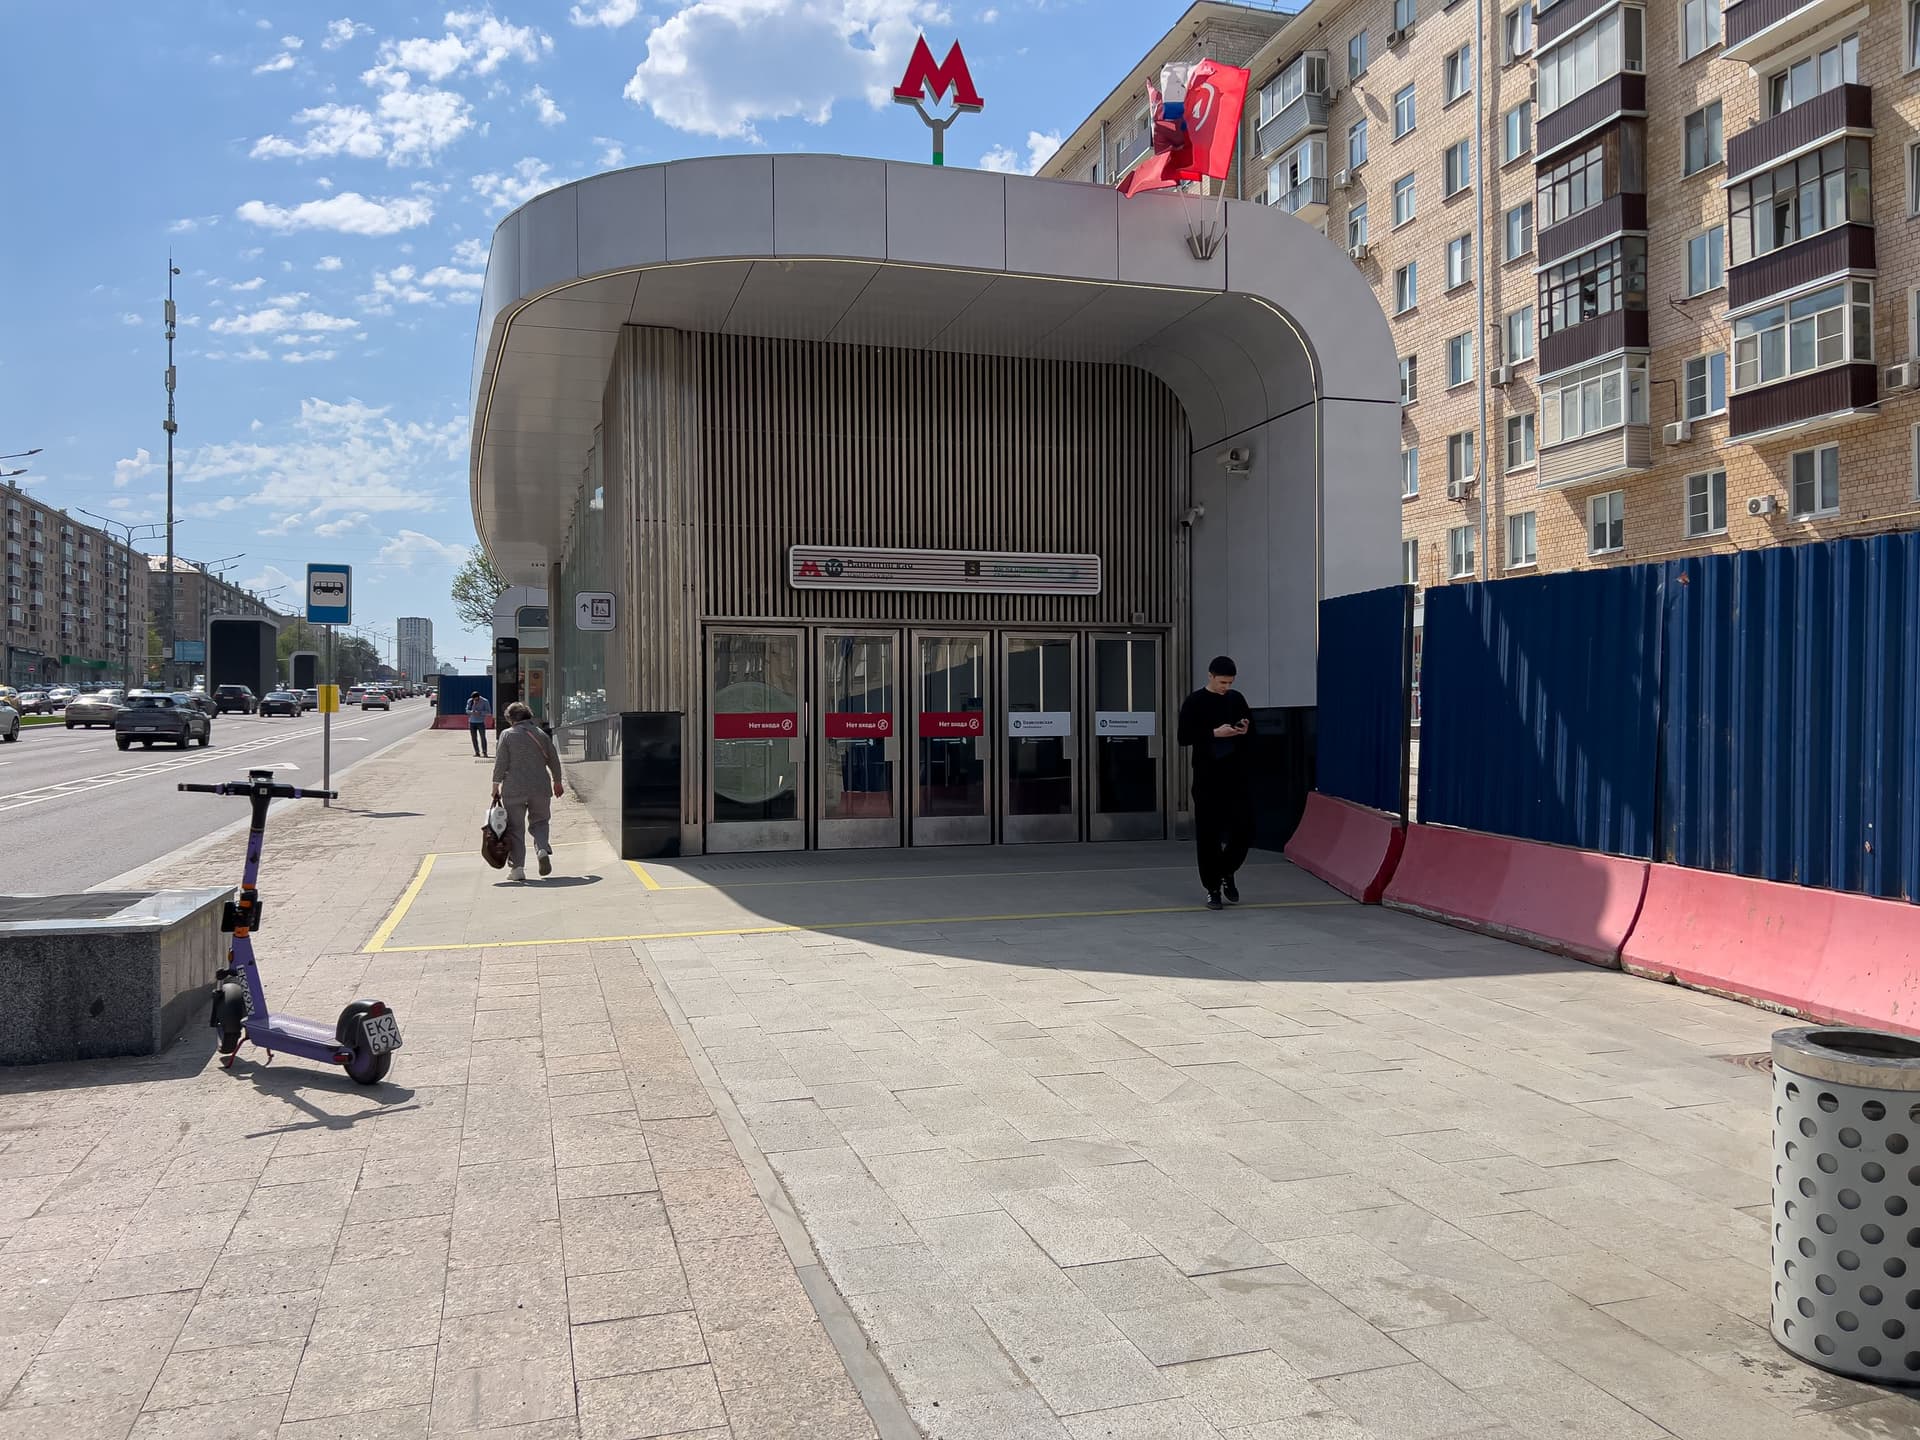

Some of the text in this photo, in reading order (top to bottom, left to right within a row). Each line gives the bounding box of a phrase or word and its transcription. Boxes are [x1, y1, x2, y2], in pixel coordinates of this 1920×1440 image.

[748, 721, 780, 730] Нет входа
[845, 721, 876, 730] Нет входа
